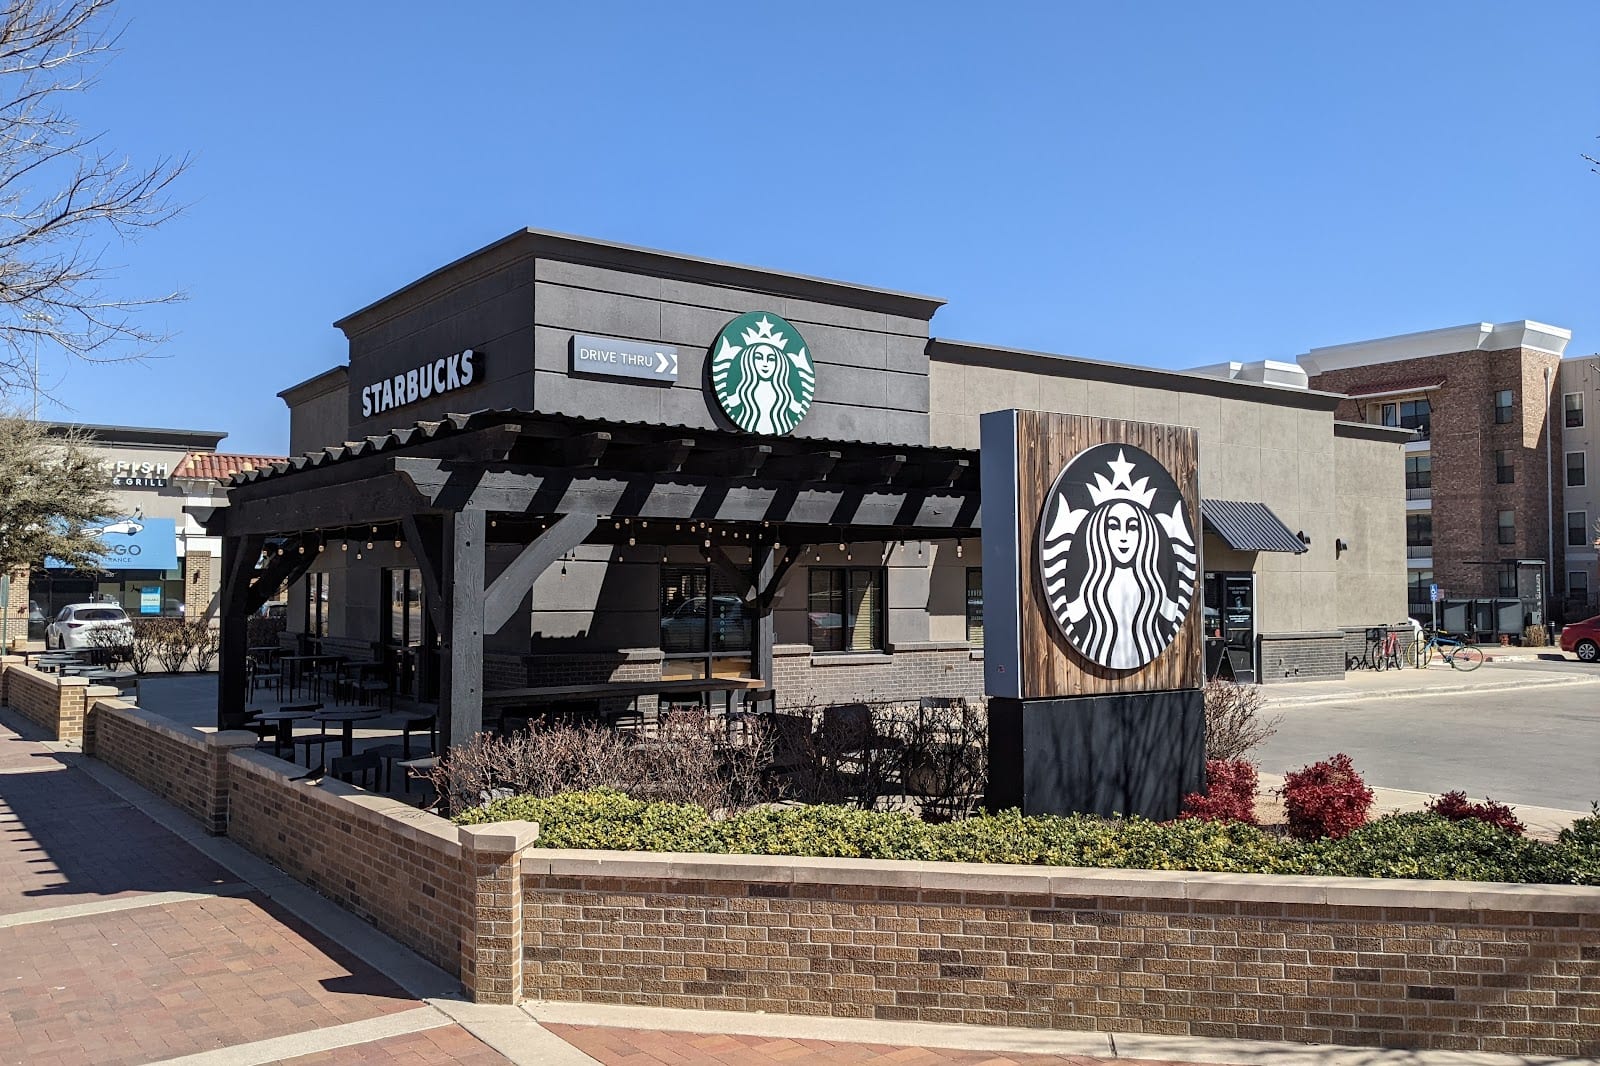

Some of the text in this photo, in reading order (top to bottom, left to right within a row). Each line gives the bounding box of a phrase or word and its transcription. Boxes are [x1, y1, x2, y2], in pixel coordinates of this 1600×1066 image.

[580, 348, 653, 367] DRIVE THRU
[362, 349, 474, 417] STARBUCKS
[125, 478, 163, 487] GRILL
